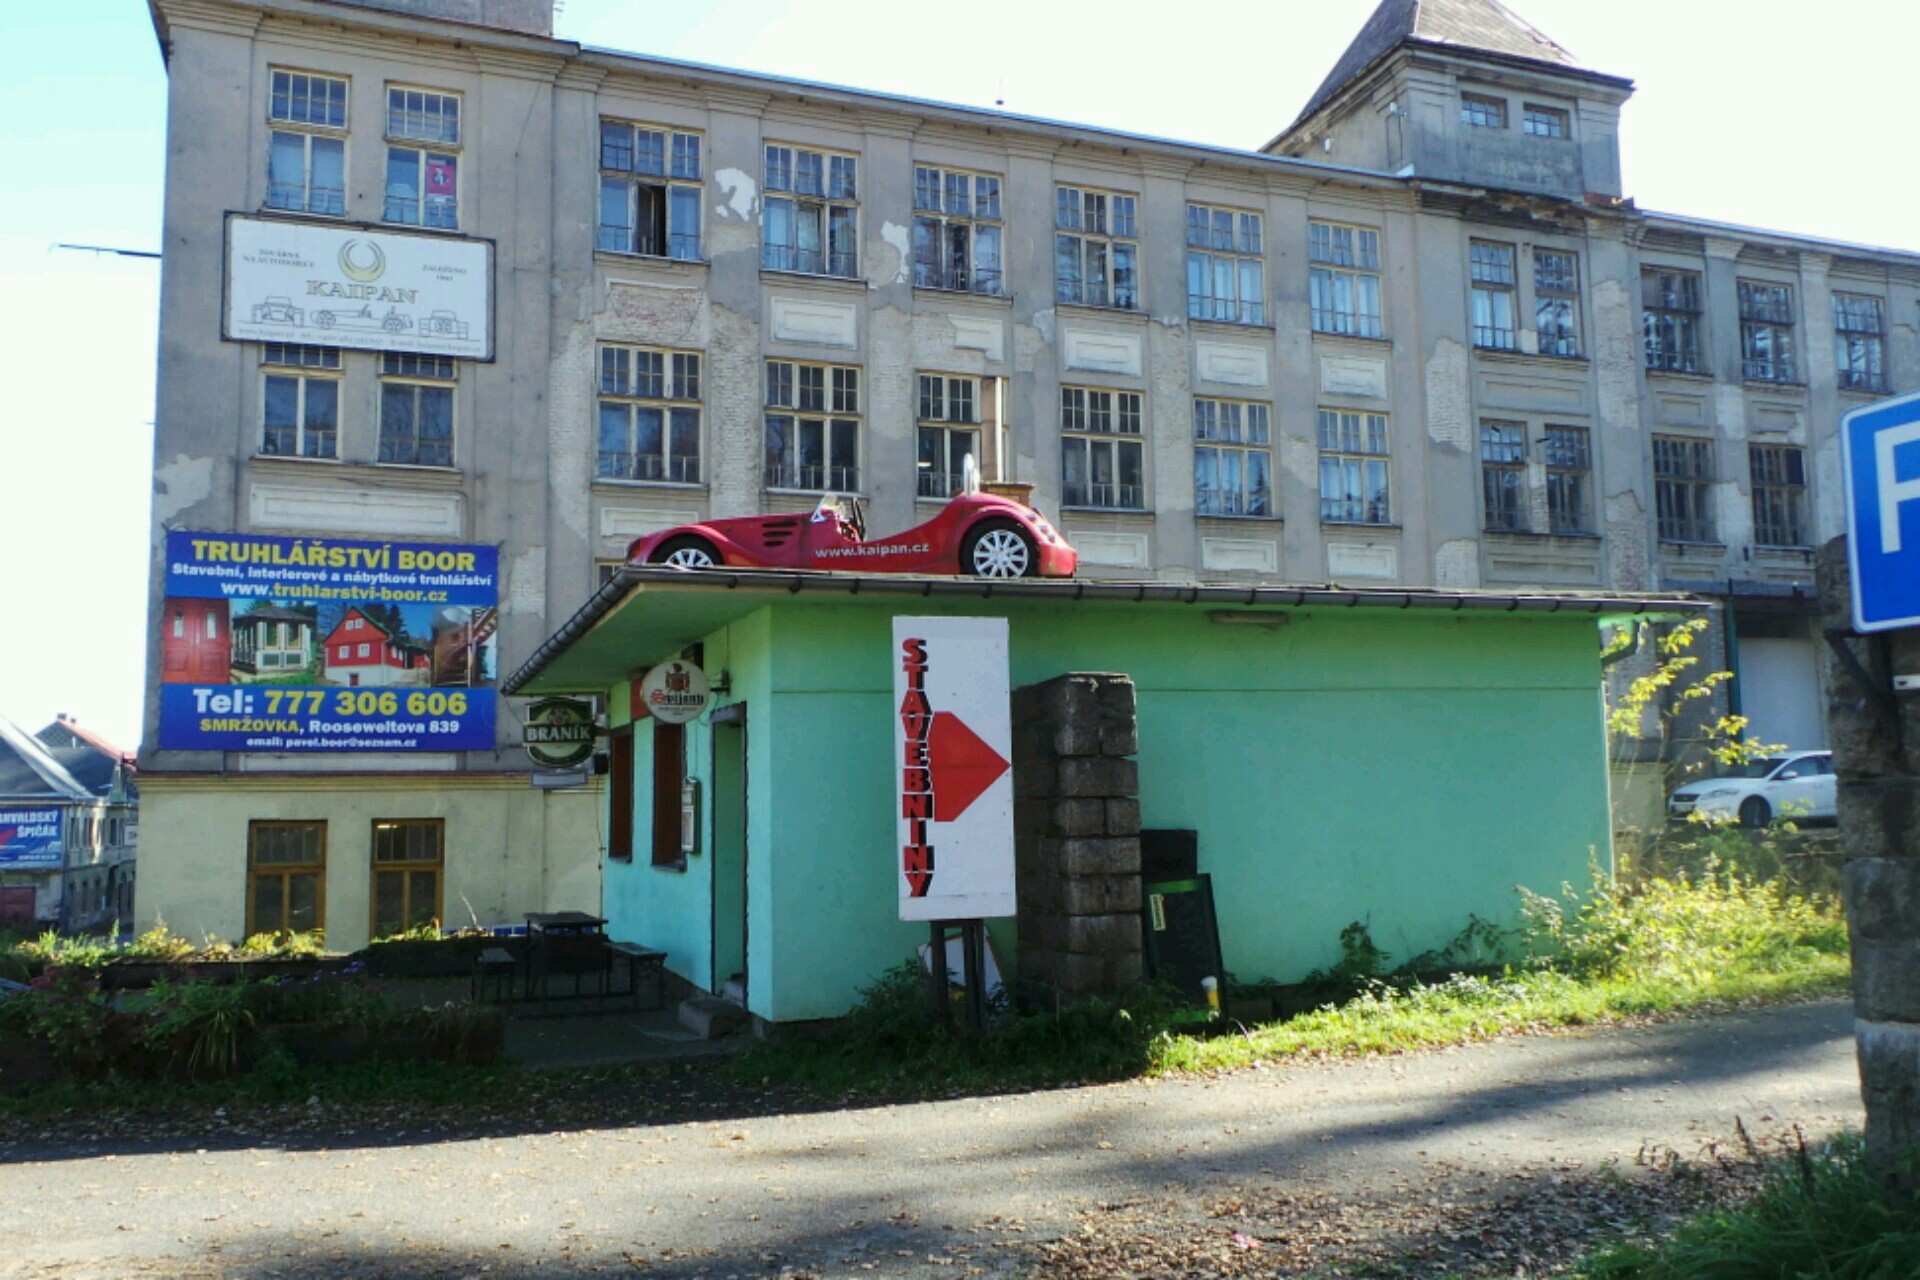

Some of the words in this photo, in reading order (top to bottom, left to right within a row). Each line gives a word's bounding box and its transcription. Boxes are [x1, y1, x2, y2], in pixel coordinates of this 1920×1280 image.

[306, 280, 418, 304] KAIPAN
[191, 540, 391, 569] TRUHLÁŘSTVÍ
[399, 551, 476, 571] BOOR
[815, 543, 929, 558] www.kaipan.cz
[172, 563, 244, 579] Stavební,
[331, 573, 340, 582] a
[344, 570, 416, 585] nábytkové
[419, 573, 492, 587] truhlářství
[221, 582, 448, 602] www.truhlarstvi-boor.cz
[193, 688, 254, 714] Tel:
[264, 691, 325, 715] 777
[335, 692, 398, 716] 306
[406, 693, 467, 716] 606
[200, 716, 305, 735] SMRŽOVKA,
[429, 720, 459, 733] 839
[527, 724, 590, 741] BRANÍK
[246, 738, 283, 748] email:
[286, 737, 417, 749] pavel.boor@seznam.cz
[901, 638, 934, 897] STAVEBNINY
